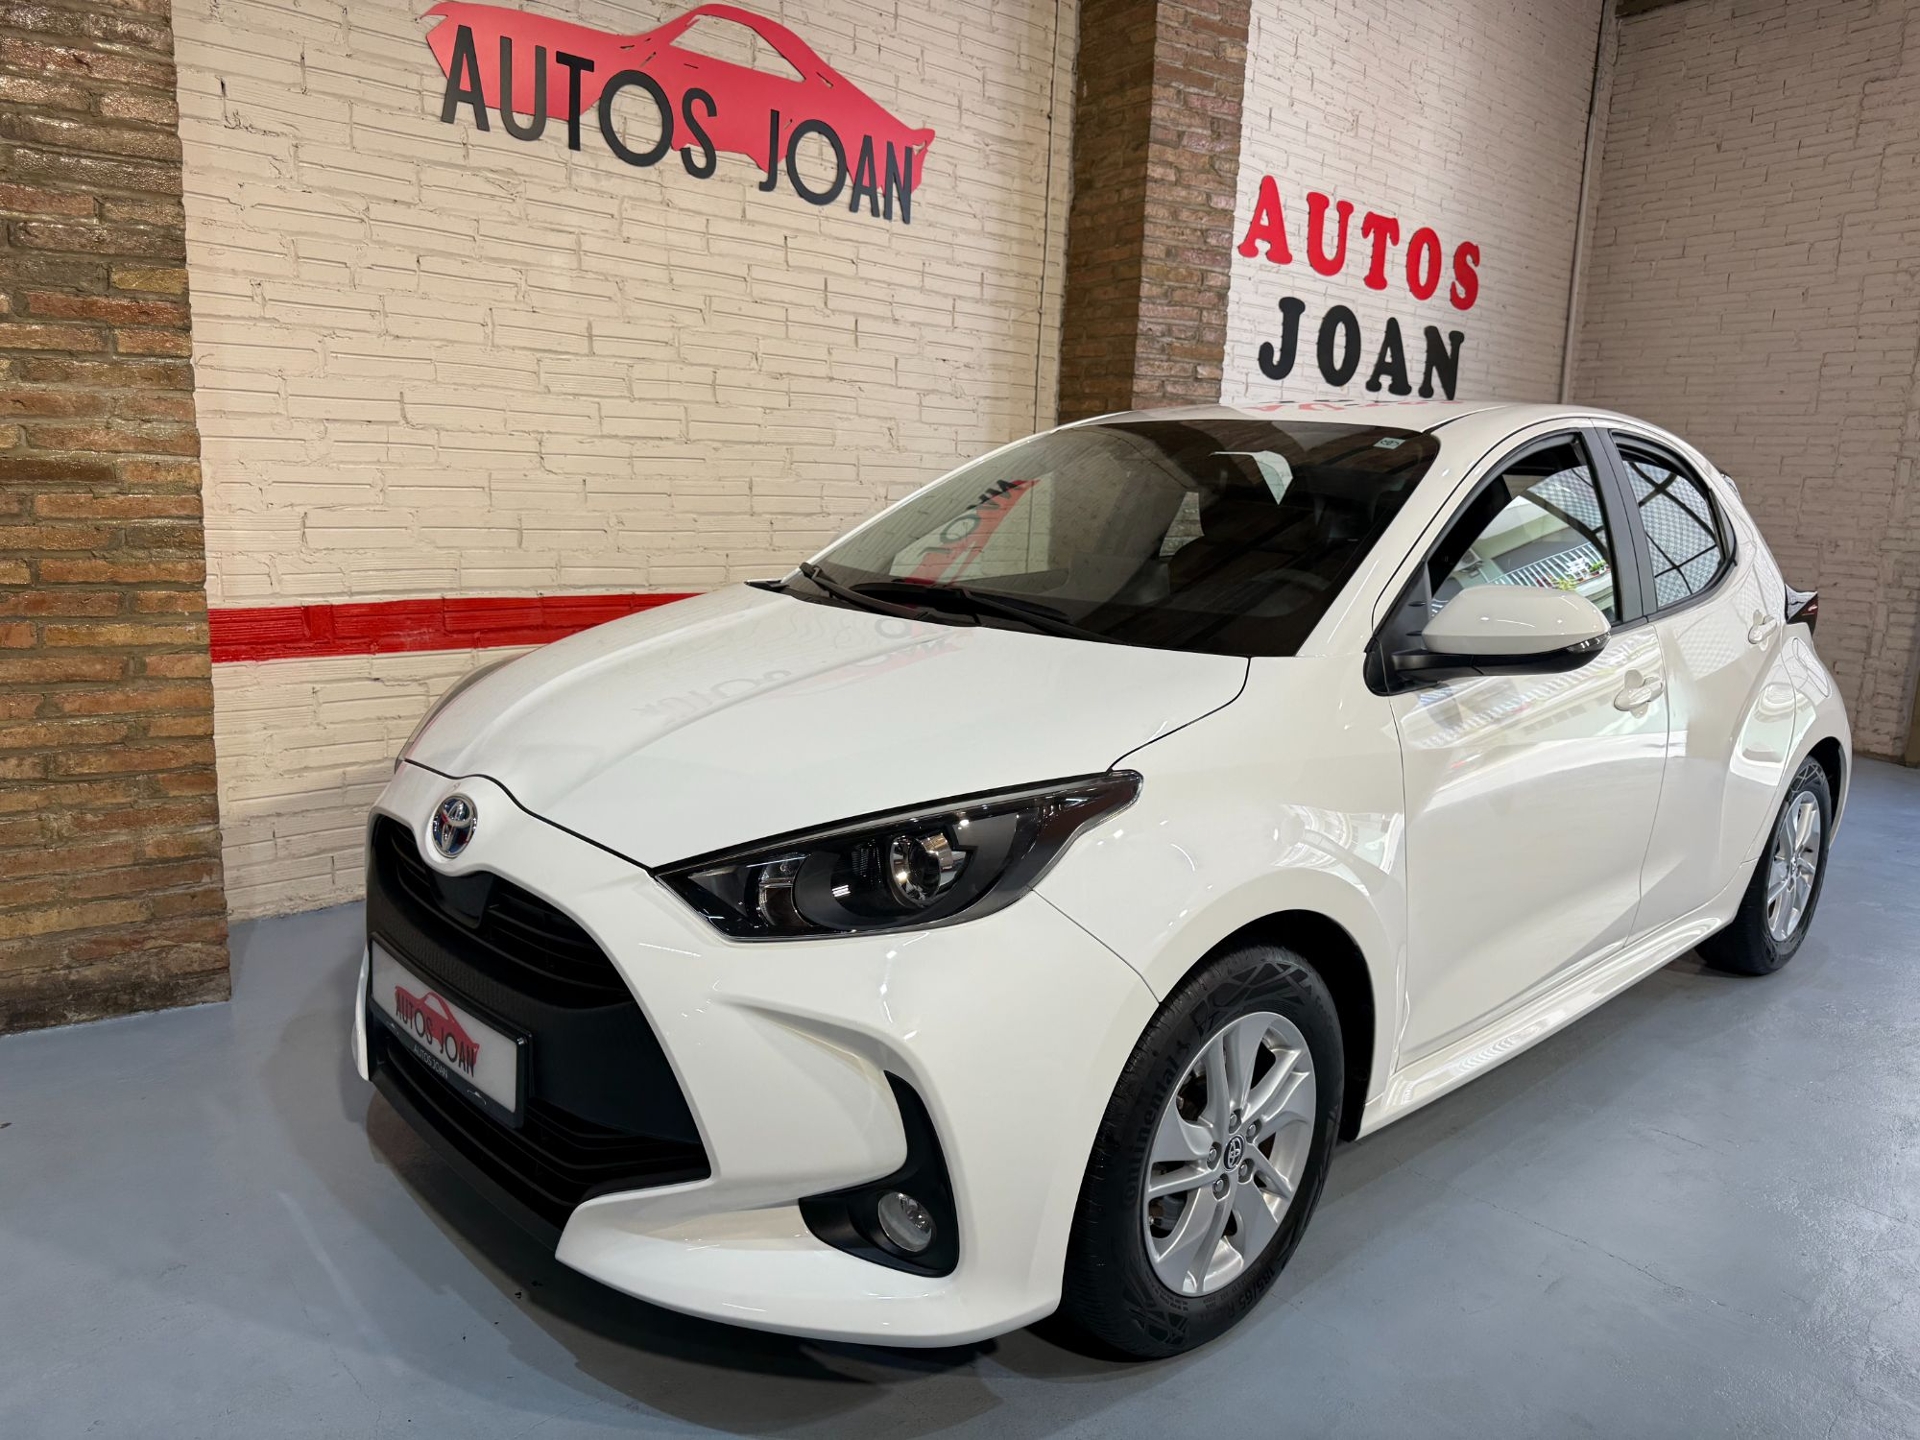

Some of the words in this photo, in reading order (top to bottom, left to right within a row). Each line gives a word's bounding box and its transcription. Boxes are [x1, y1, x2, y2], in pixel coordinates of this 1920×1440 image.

[440, 25, 717, 179] AUTOS
[758, 109, 912, 224] JOAN
[1238, 175, 1480, 310] AUTOS
[1258, 297, 1464, 400] JOAN
[395, 990, 433, 1045] AUTOS
[440, 1026, 475, 1079] JOAN
